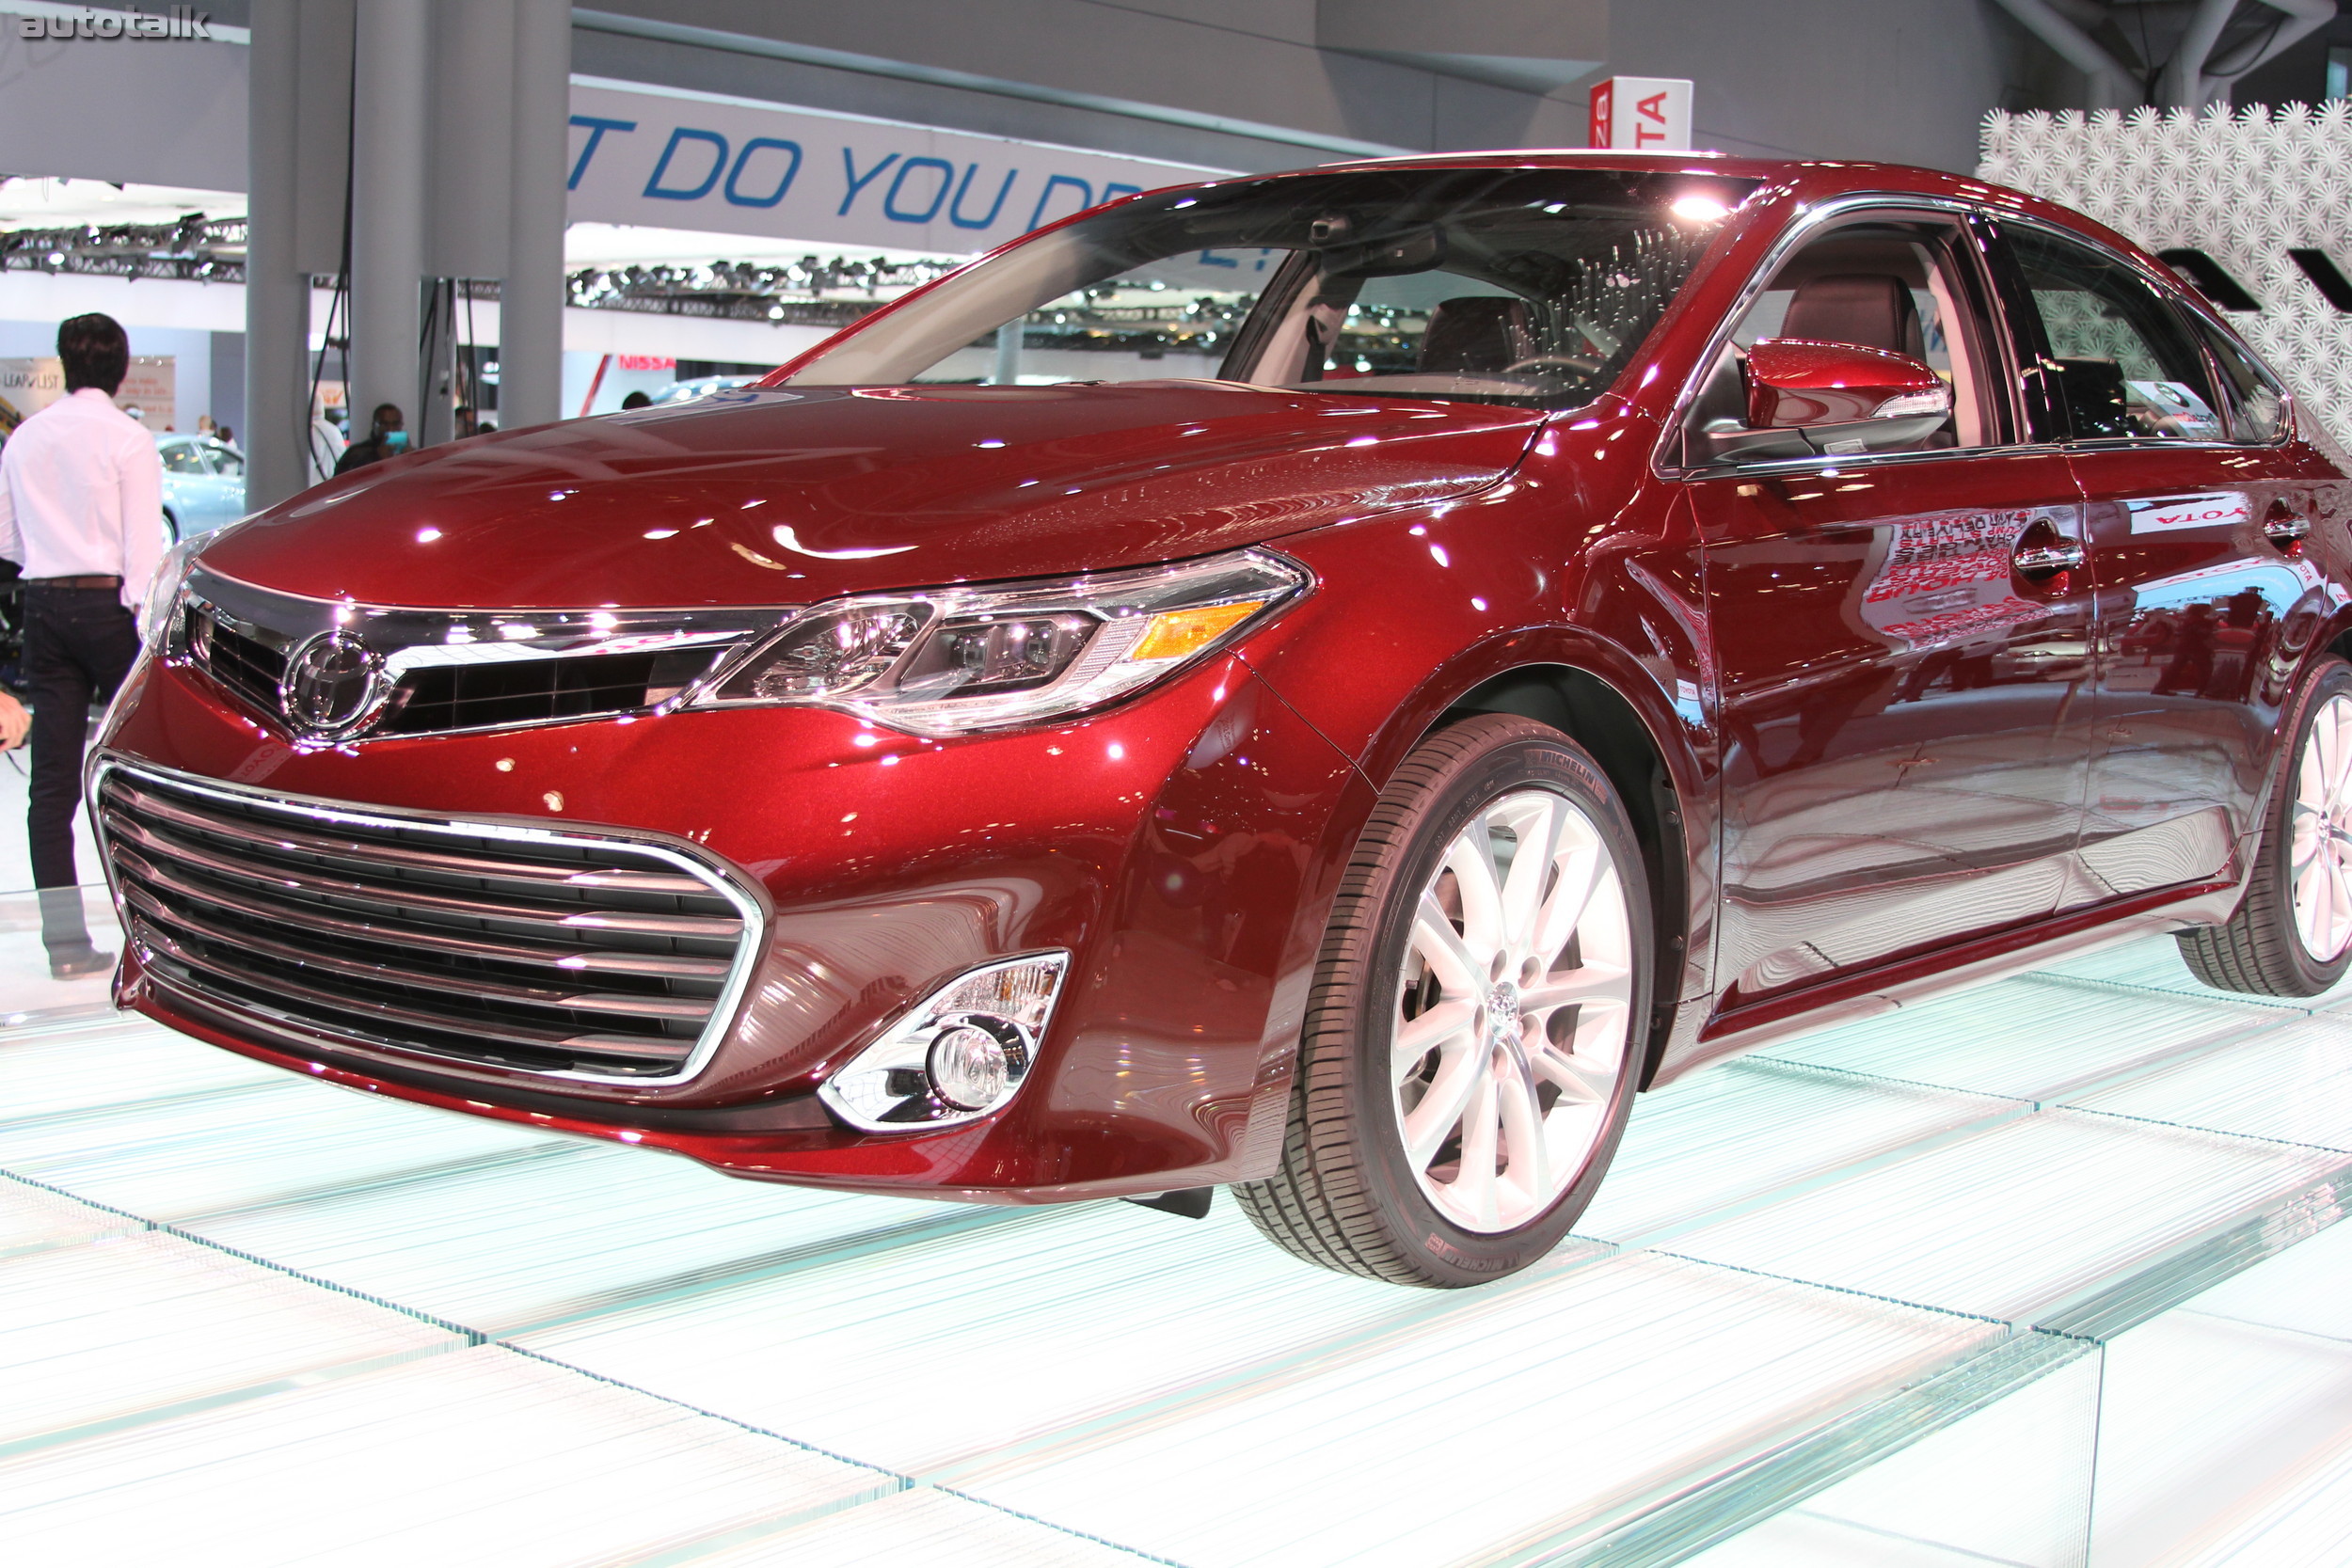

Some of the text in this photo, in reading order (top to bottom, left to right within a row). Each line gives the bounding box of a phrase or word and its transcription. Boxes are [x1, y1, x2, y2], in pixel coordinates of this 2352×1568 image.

[642, 127, 803, 209] DO
[837, 147, 1018, 230] YOU
[1540, 751, 1596, 785] MICHELIN
